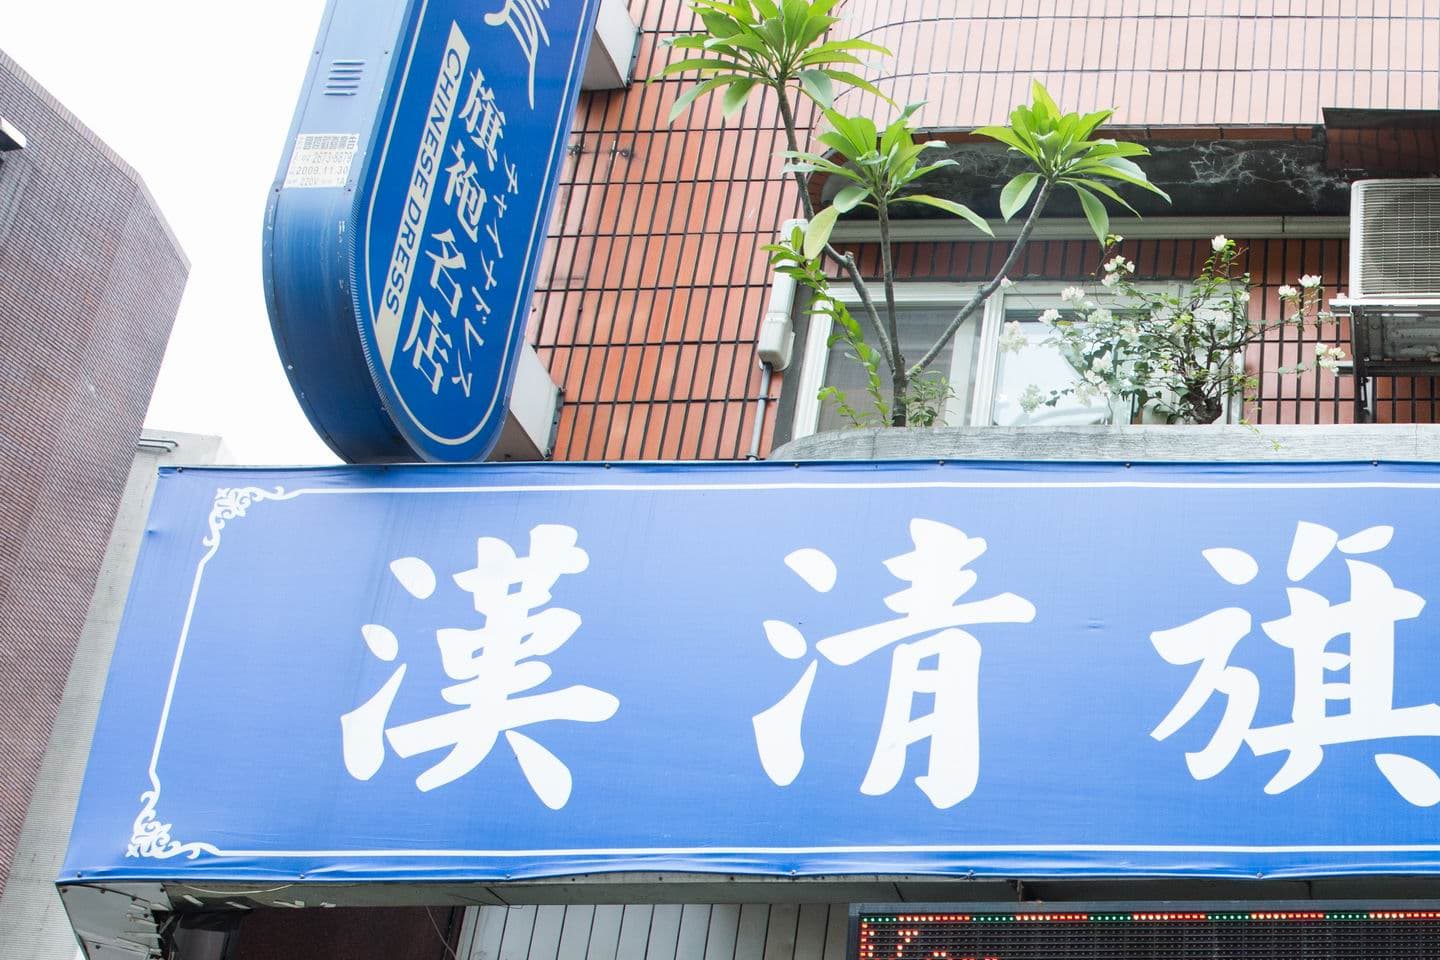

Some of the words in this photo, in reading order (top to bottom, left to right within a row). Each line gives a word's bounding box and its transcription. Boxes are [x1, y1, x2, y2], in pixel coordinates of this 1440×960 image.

[414, 48, 462, 198] CHINESE
[386, 199, 422, 315] DRESS
[402, 68, 506, 395] 旗袍名店
[451, 153, 519, 398] チャイナドレス
